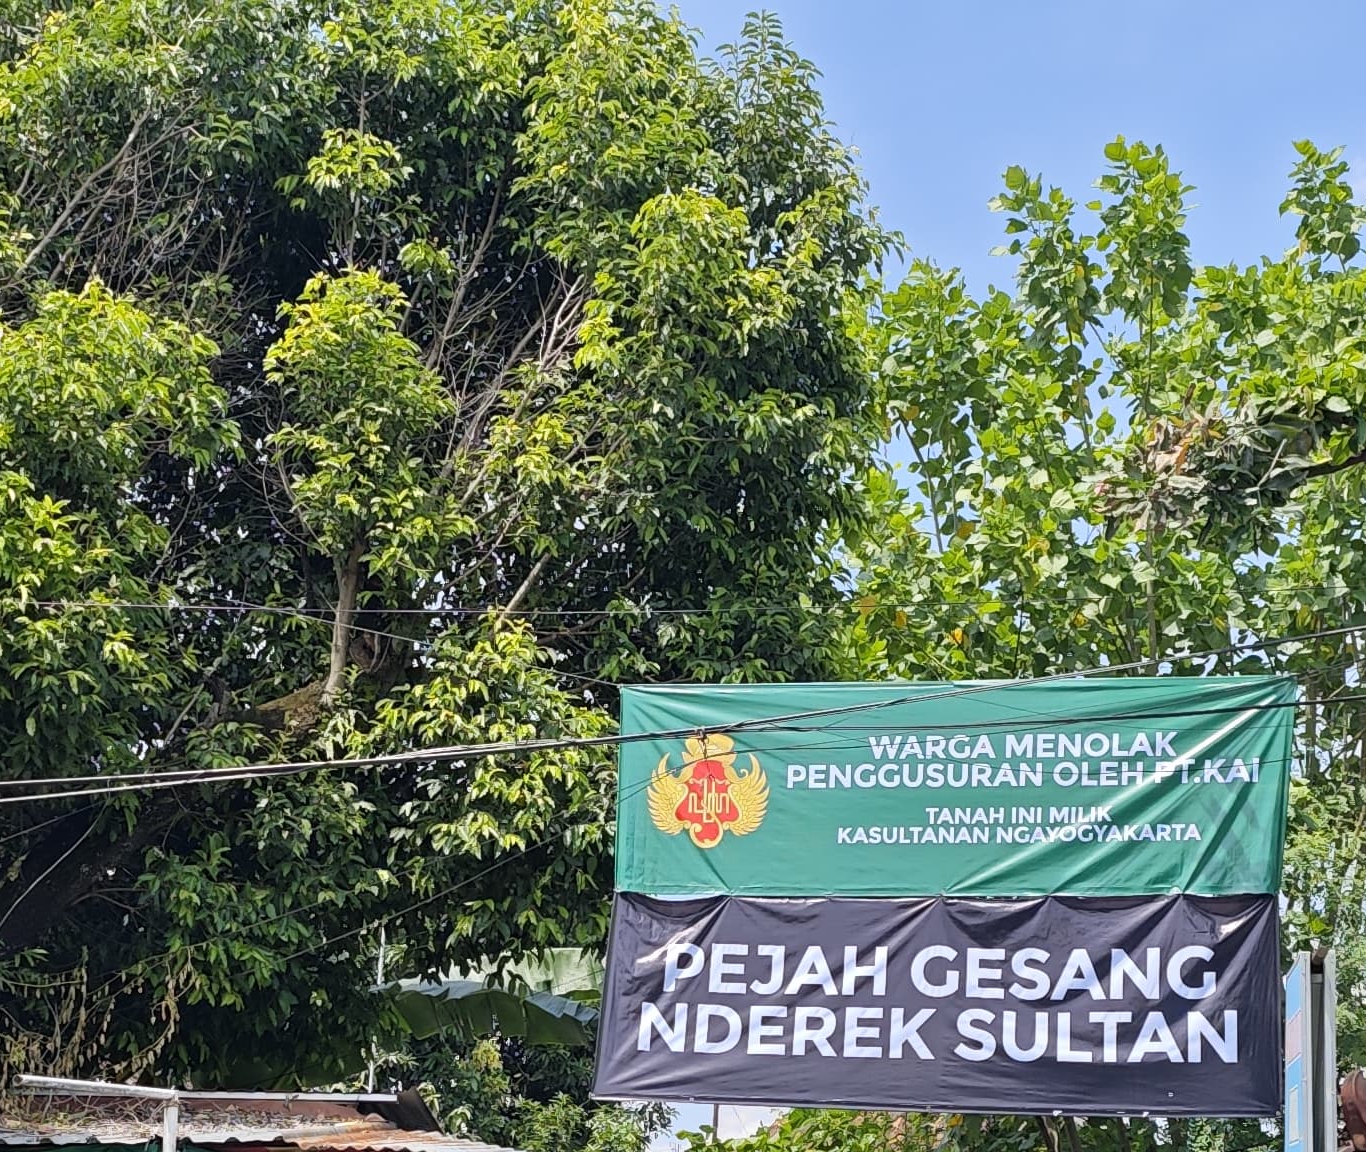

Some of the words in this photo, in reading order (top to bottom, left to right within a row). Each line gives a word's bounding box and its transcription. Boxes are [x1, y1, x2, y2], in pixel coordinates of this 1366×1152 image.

[869, 734, 997, 760] WARGA
[1005, 732, 1178, 759] MENOLAK
[787, 763, 1044, 790] PENGGUSURAN
[1053, 761, 1144, 787] OLEH
[1153, 757, 1260, 786] PT.KAI
[925, 807, 1006, 826] TANAH
[1012, 806, 1043, 825] INI
[1048, 805, 1113, 824] MILIK
[836, 826, 991, 845] KASULTANAN
[996, 822, 1202, 843] NGAYOGYAKARTA
[662, 943, 888, 997] PEJAH
[910, 945, 1217, 1000] GESANG
[637, 1002, 936, 1061] NDEREK
[953, 1009, 1239, 1065] SULTAN
